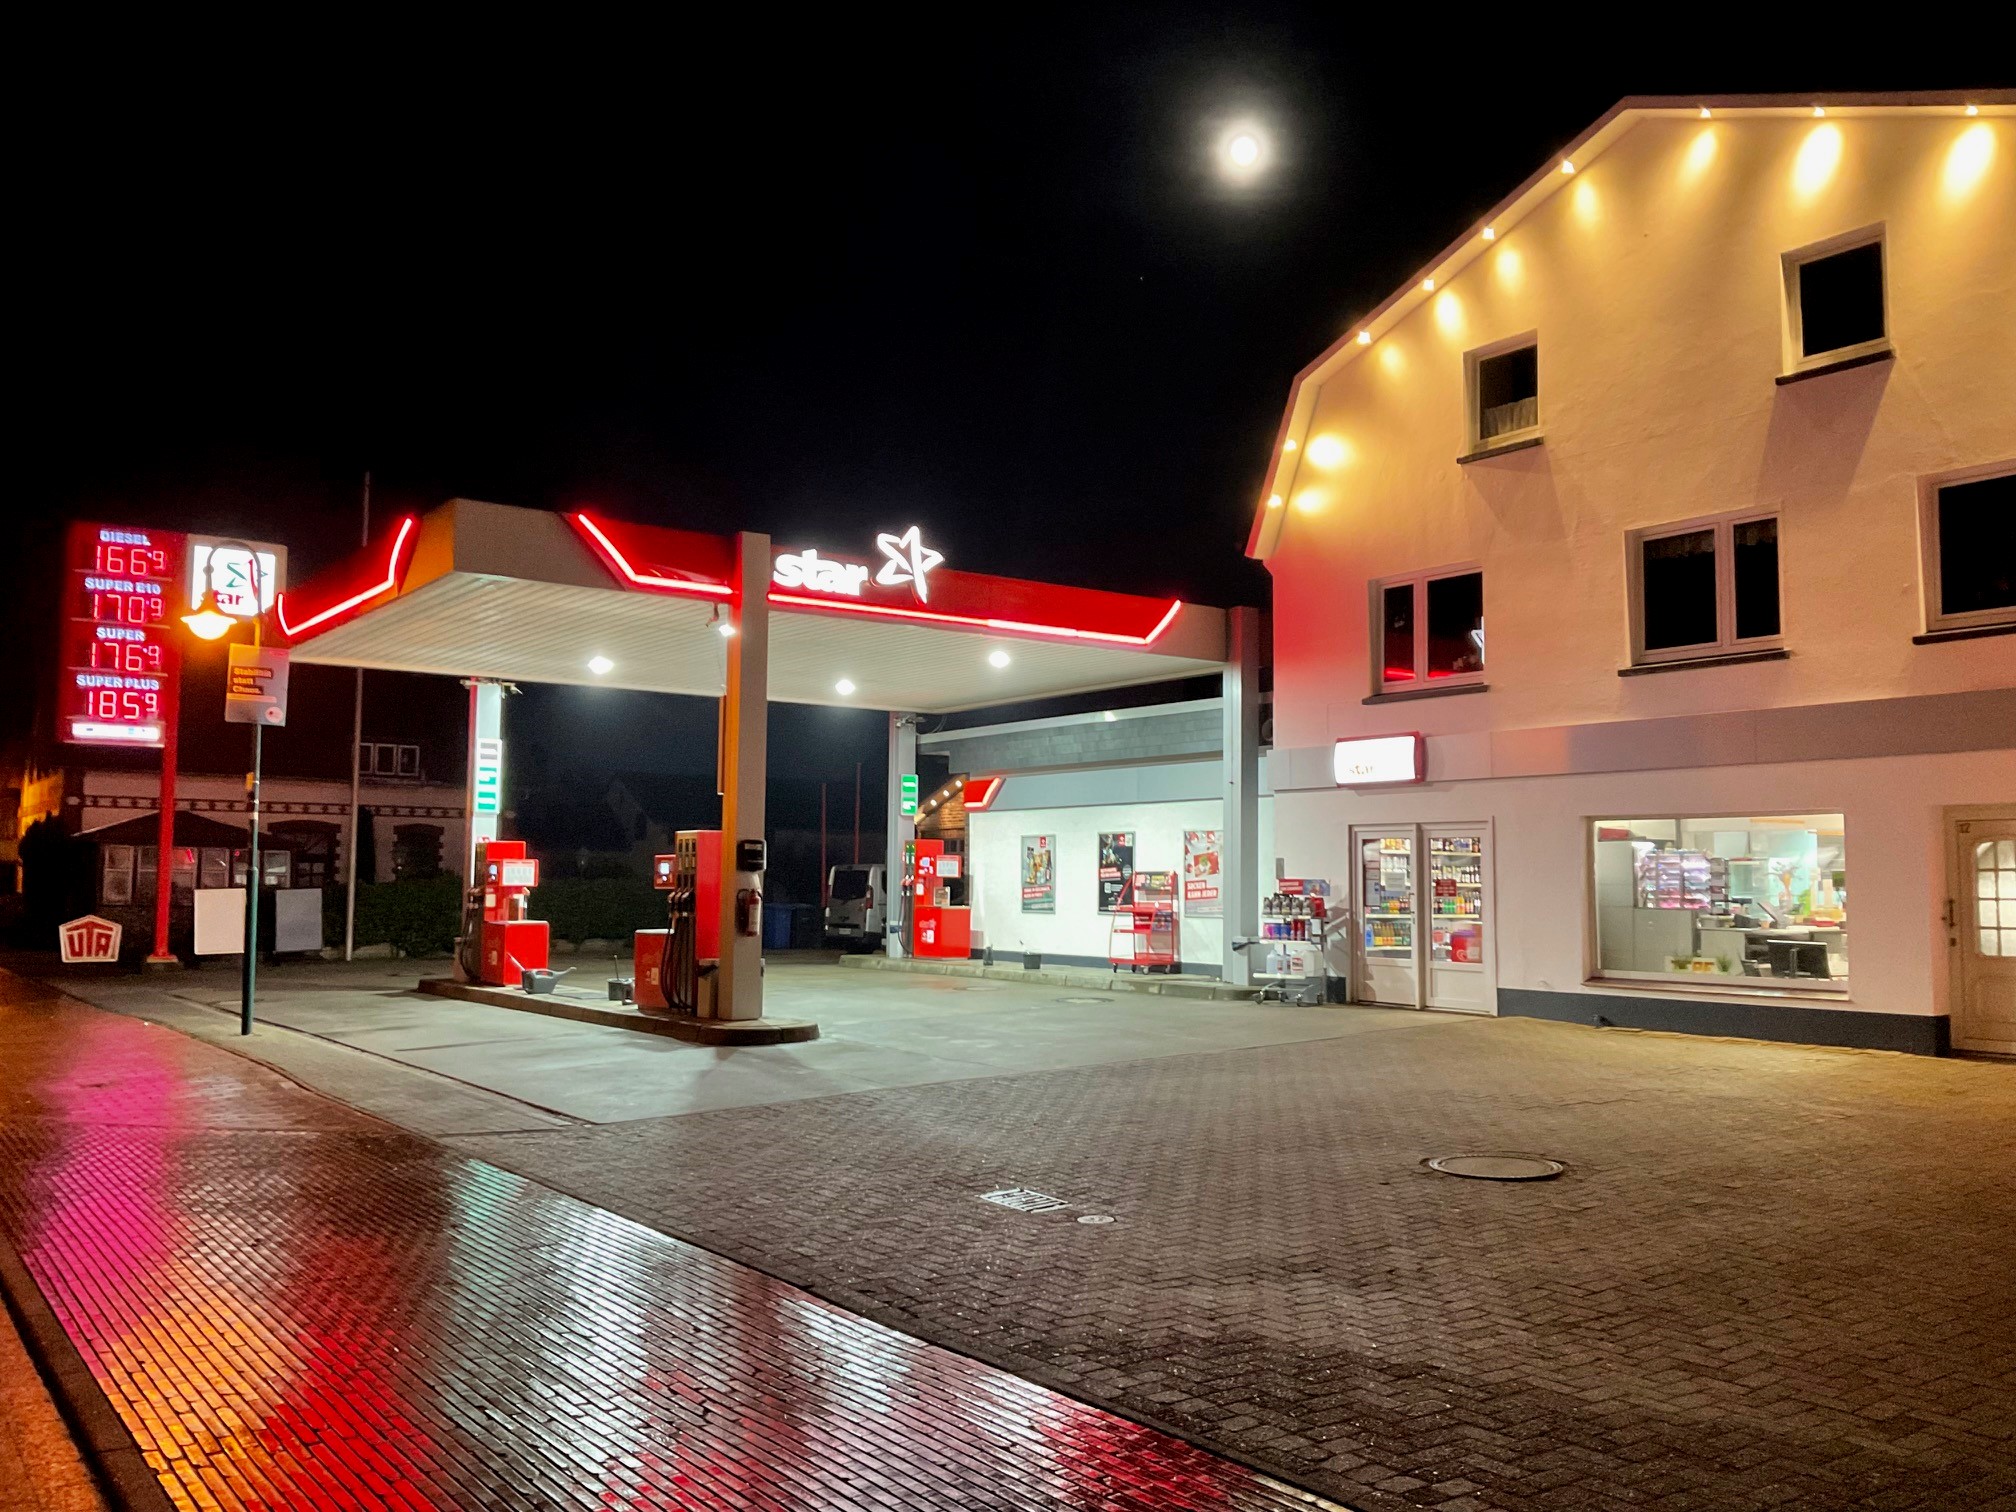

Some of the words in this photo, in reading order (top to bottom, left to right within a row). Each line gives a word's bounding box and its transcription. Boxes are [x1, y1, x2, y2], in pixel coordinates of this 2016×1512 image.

[100, 530, 151, 546] DIESEL
[773, 549, 868, 596] star
[85, 577, 133, 592] SUPER
[135, 582, 161, 595] E10
[96, 627, 145, 641] SUPER
[76, 674, 123, 688] SUPER
[124, 678, 159, 691] PLUS
[66, 921, 113, 957] UTA
